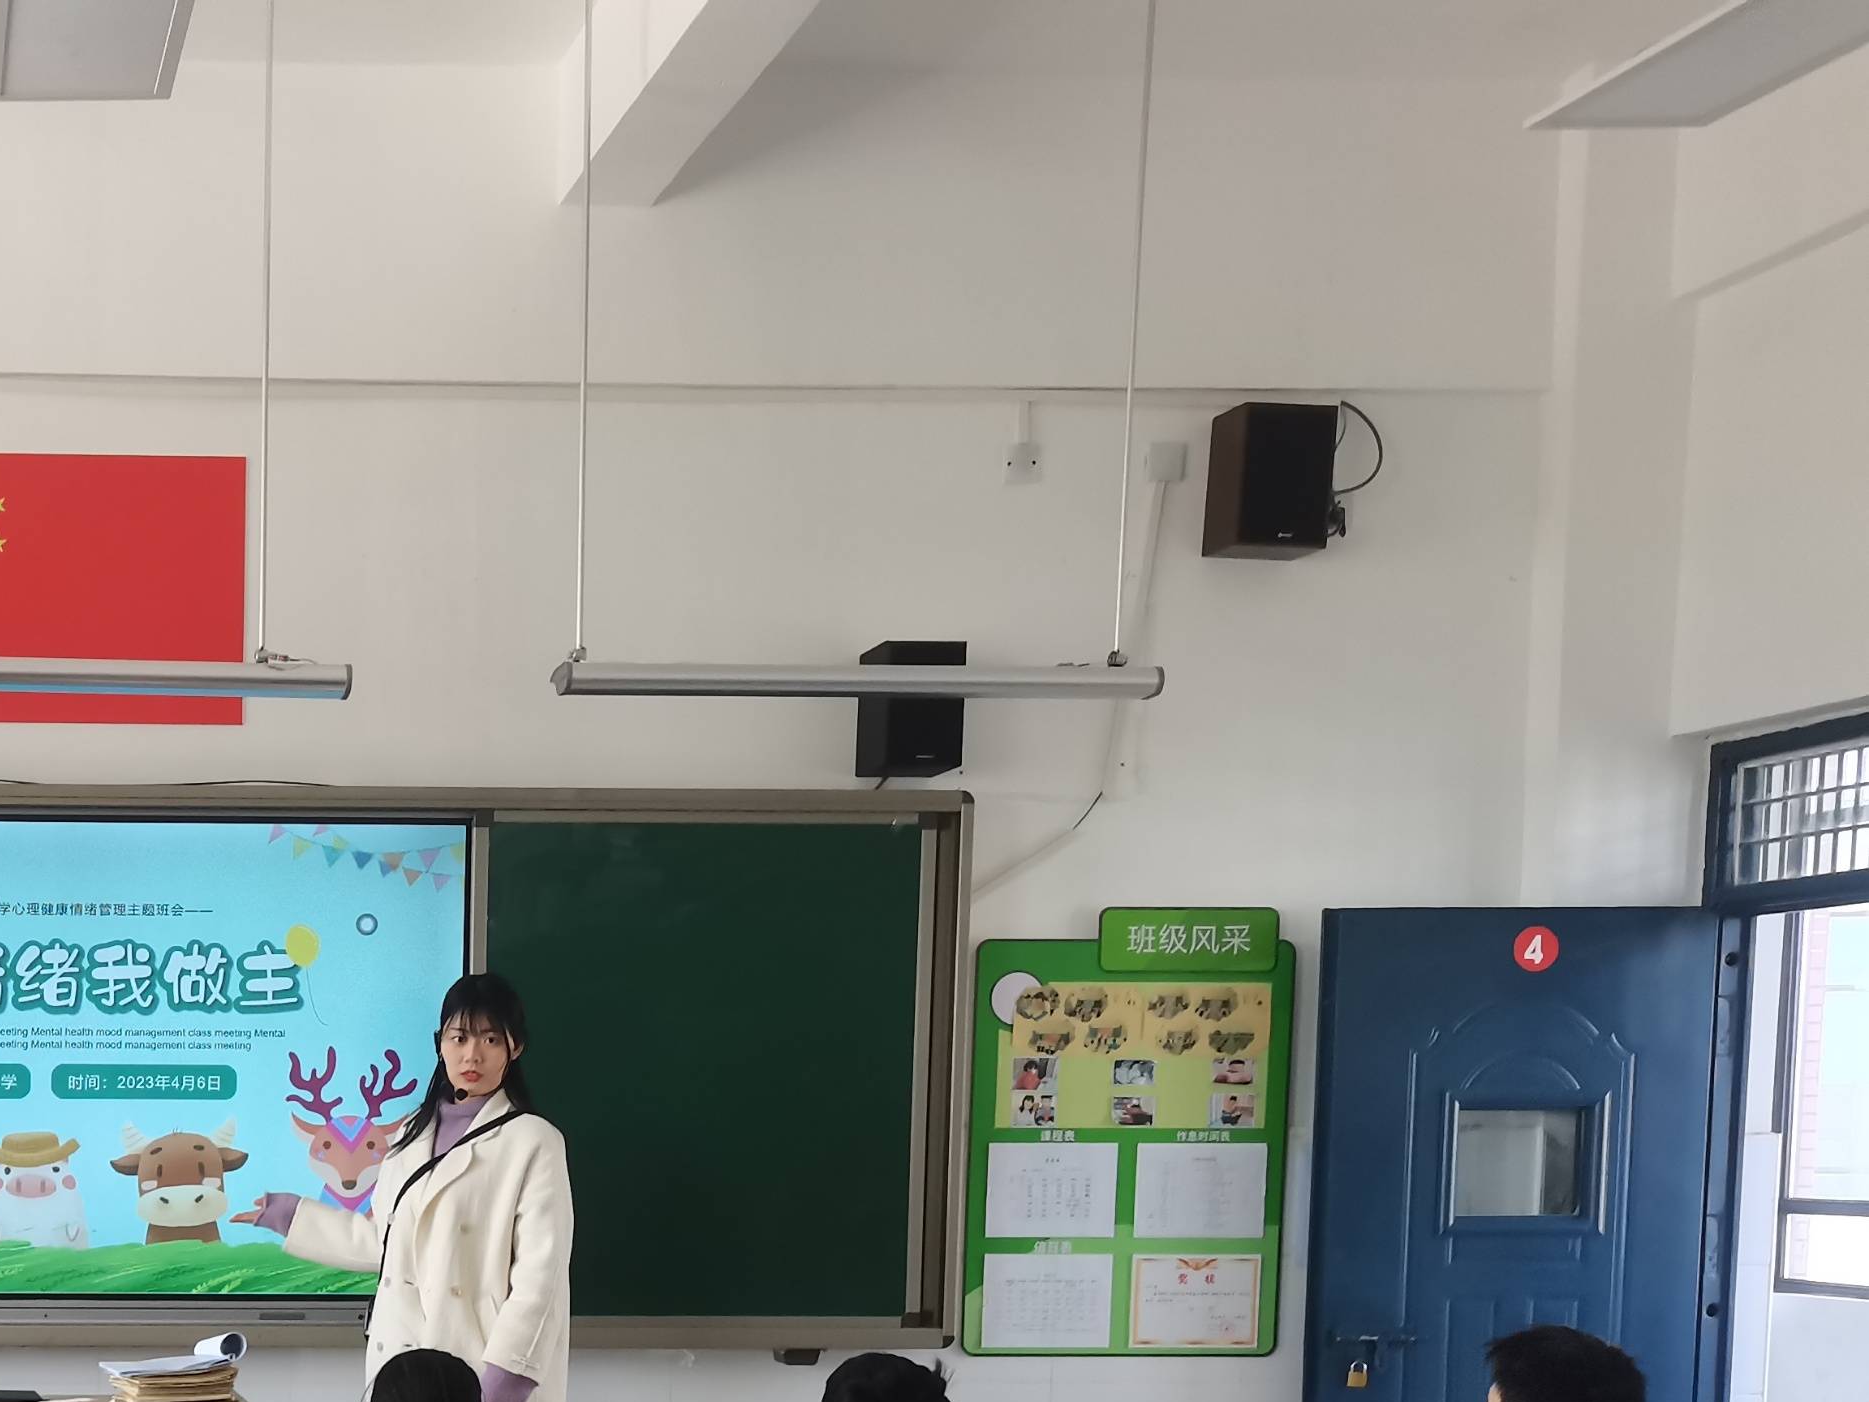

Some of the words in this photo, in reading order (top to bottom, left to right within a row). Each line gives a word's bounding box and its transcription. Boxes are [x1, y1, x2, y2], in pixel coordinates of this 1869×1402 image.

[1126, 923, 1251, 955] 班级风采
[1523, 933, 1544, 965] 4
[30, 1027, 63, 1037] Mental
[65, 1028, 94, 1037] health
[96, 1028, 123, 1037] mood
[125, 1028, 187, 1039] management
[188, 1028, 213, 1038] class
[214, 1028, 252, 1039] meeting
[254, 1028, 286, 1038] Mental
[30, 1040, 63, 1049] Mental
[65, 1040, 94, 1049] health
[96, 1040, 123, 1049] mood
[125, 1041, 187, 1051] management
[188, 1040, 213, 1050] class
[214, 1041, 252, 1052] meeting
[67, 1073, 222, 1092] 时间：2023年4月6日
